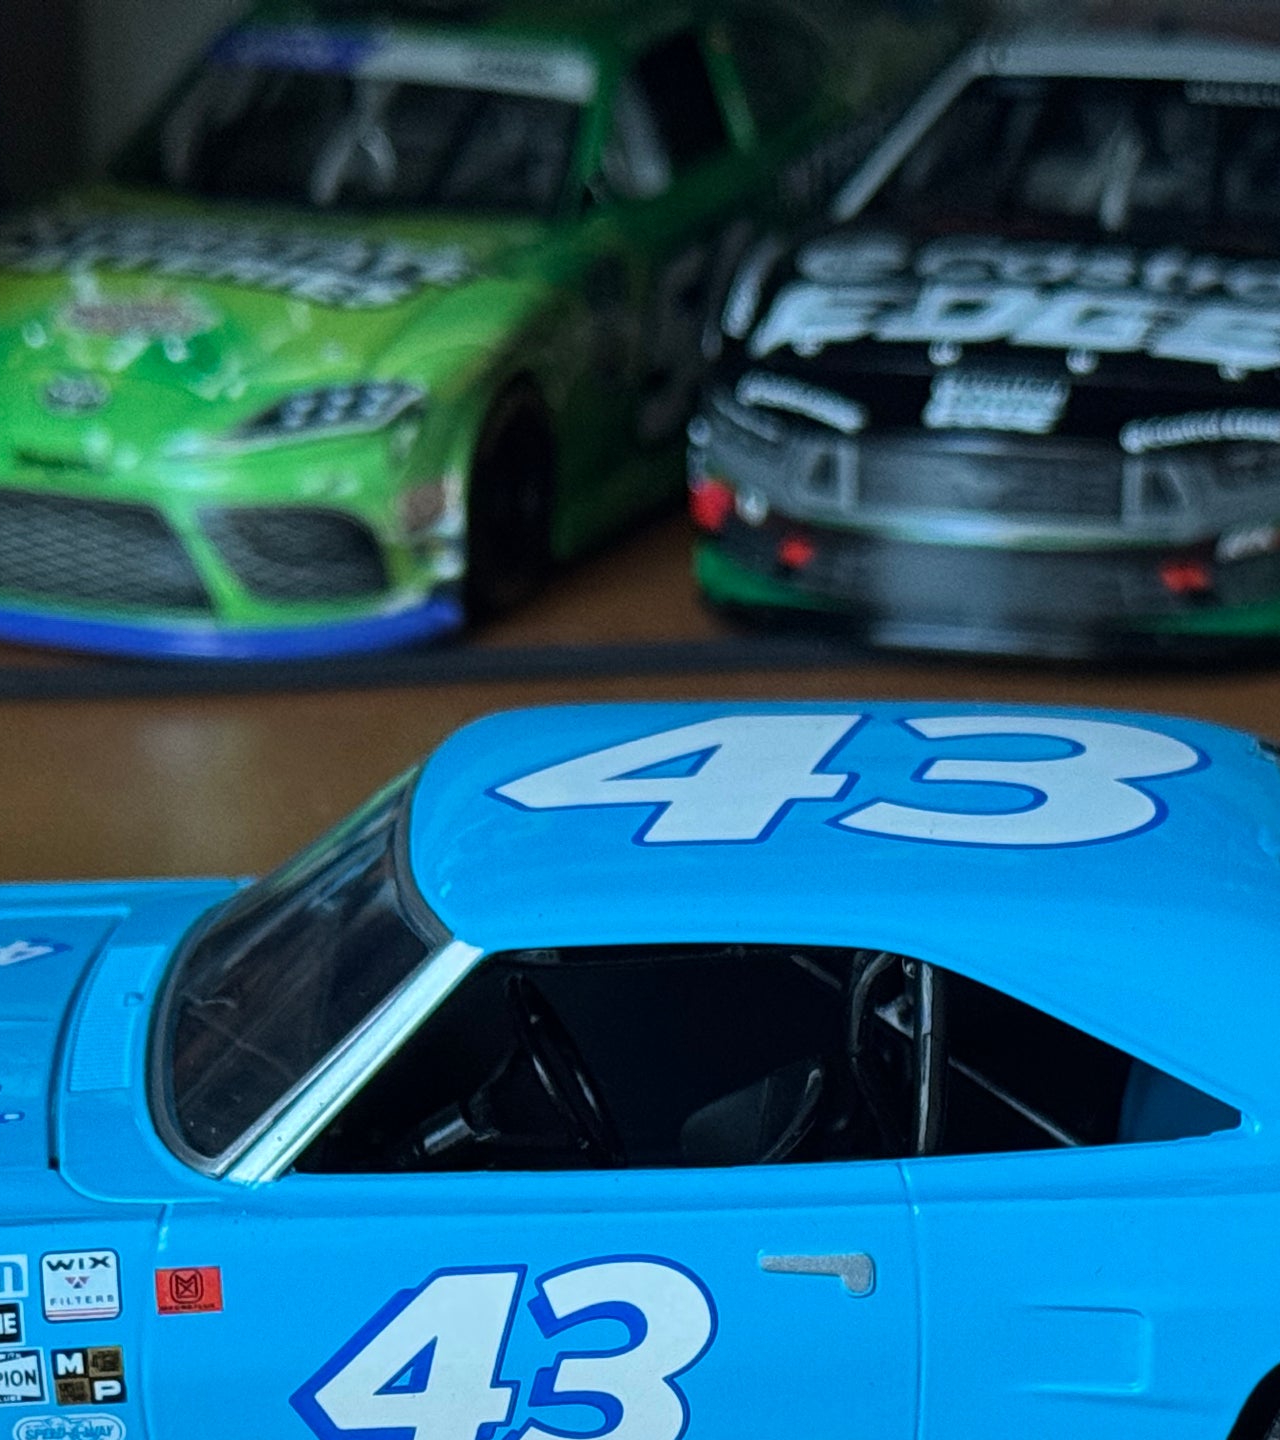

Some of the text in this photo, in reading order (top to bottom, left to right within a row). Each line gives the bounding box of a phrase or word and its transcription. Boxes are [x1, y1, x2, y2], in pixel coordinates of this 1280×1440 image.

[486, 713, 1211, 849] 43
[46, 1255, 111, 1271] WIX
[49, 1294, 115, 1307] FILTERS
